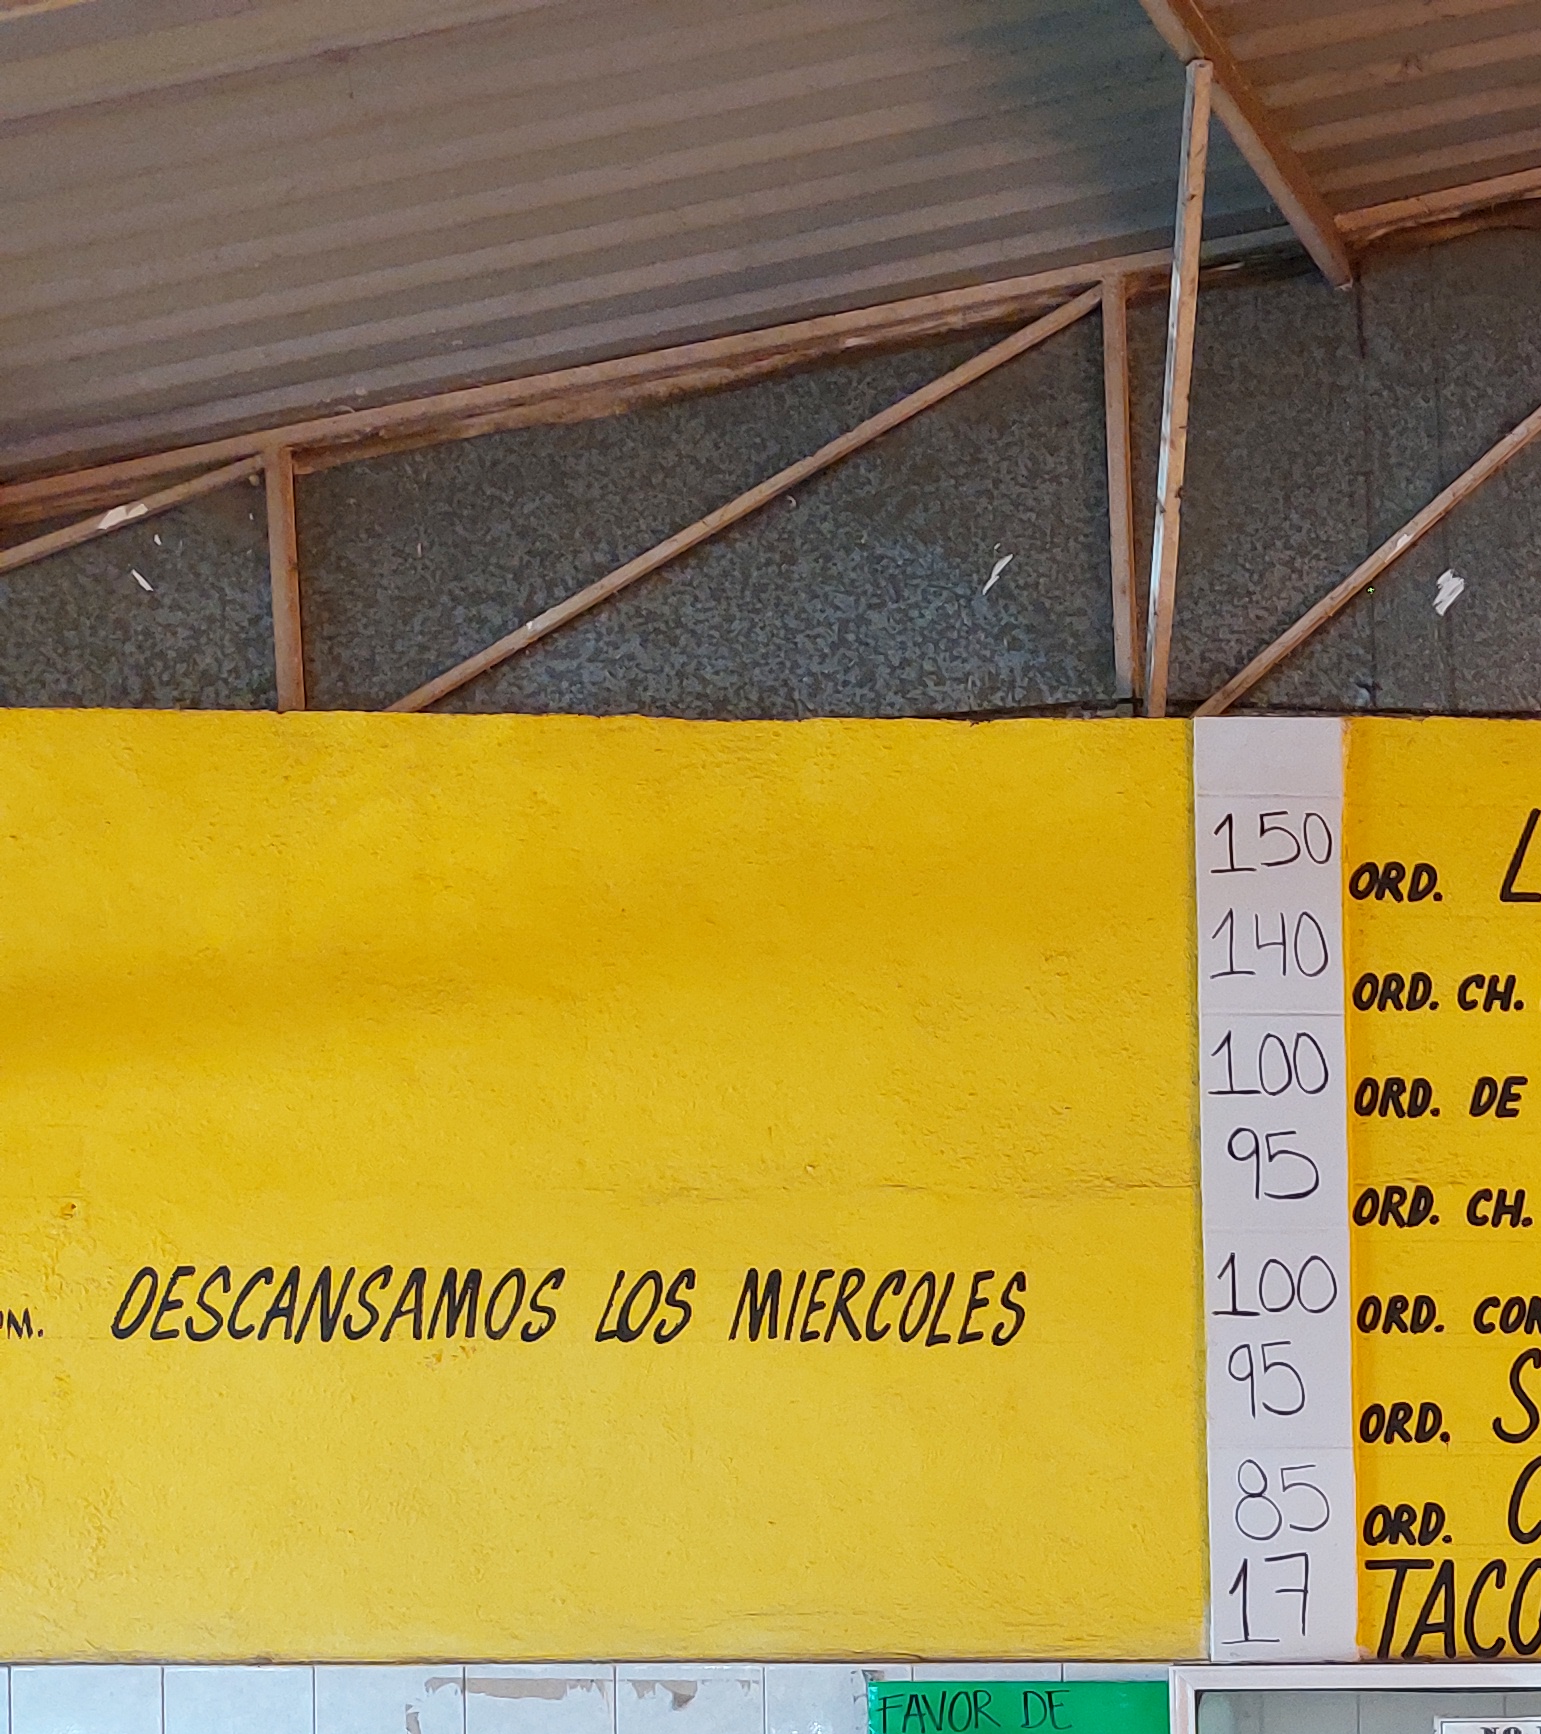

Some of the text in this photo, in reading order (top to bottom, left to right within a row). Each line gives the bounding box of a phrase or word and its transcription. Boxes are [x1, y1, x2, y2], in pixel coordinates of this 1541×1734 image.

[1211, 811, 1332, 873] 150
[1349, 862, 1442, 903] ORD.
[1210, 908, 1328, 979] 140
[1352, 972, 1439, 1012] ORD.
[1458, 974, 1524, 1012] CH.
[1208, 1030, 1329, 1096] 100
[1354, 1077, 1440, 1118] ORD.
[1469, 1076, 1528, 1118] DE
[1228, 1128, 1319, 1200] 95
[1353, 1185, 1439, 1228] ORD.
[1467, 1188, 1533, 1228] CH.
[595, 1268, 696, 1344] LOS
[729, 1268, 1026, 1347] MIERCOLES
[1212, 1252, 1337, 1316] 100
[1357, 1295, 1444, 1334] ORD.
[1228, 1341, 1305, 1419] 95
[1360, 1402, 1450, 1445] ORD.
[1235, 1459, 1329, 1540] 85
[1363, 1502, 1452, 1546] ORD.
[1222, 1552, 1309, 1644] 17
[876, 1690, 1072, 1734] FAVOR DE
